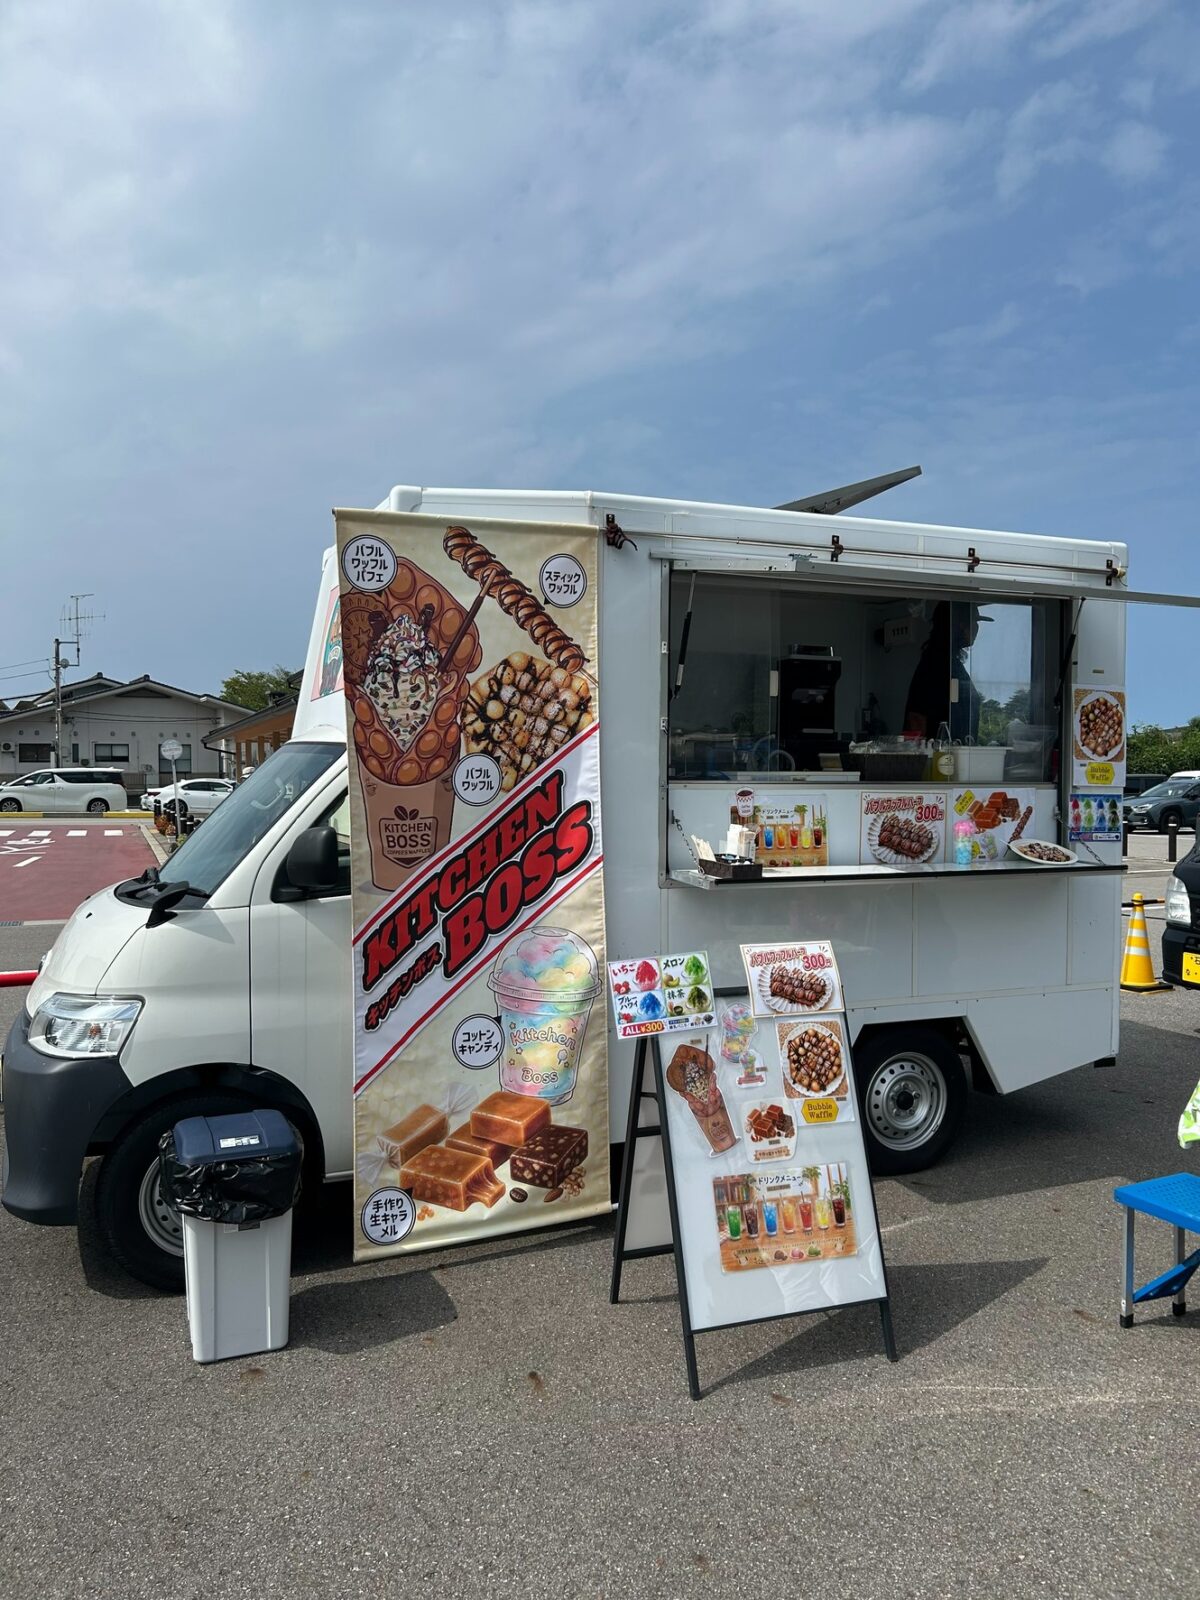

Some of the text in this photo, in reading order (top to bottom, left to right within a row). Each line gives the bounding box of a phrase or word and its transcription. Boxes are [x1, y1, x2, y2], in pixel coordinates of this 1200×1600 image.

[355, 544, 384, 557] バブル
[351, 558, 388, 570] ワッフル
[545, 571, 581, 583] スティック
[549, 583, 577, 595] ワッフル
[465, 768, 491, 779] バブル
[462, 780, 494, 791] ワッフル
[384, 822, 432, 833] KITCHEN
[385, 833, 431, 848] BOSS
[364, 769, 563, 990] KITCHEN
[443, 801, 593, 977] BOSS
[612, 962, 637, 976] いちご
[663, 957, 685, 970] メロン
[365, 942, 443, 1030] キッチンボス
[618, 995, 638, 1005] ブルー
[667, 988, 685, 1000] 抹茶
[620, 1001, 638, 1010] ハワイ
[462, 1030, 495, 1042] コットン
[510, 1027, 577, 1051] Kitchen
[458, 1041, 499, 1055] キャンディ
[521, 1067, 559, 1084] Boss
[807, 1102, 833, 1111] Bubble
[809, 1110, 833, 1119] Waffle
[758, 1175, 802, 1185] ドリンクメニュー
[372, 1198, 404, 1213] 手作り
[370, 1210, 408, 1227] 生キャラ
[381, 1225, 398, 1238] メル
